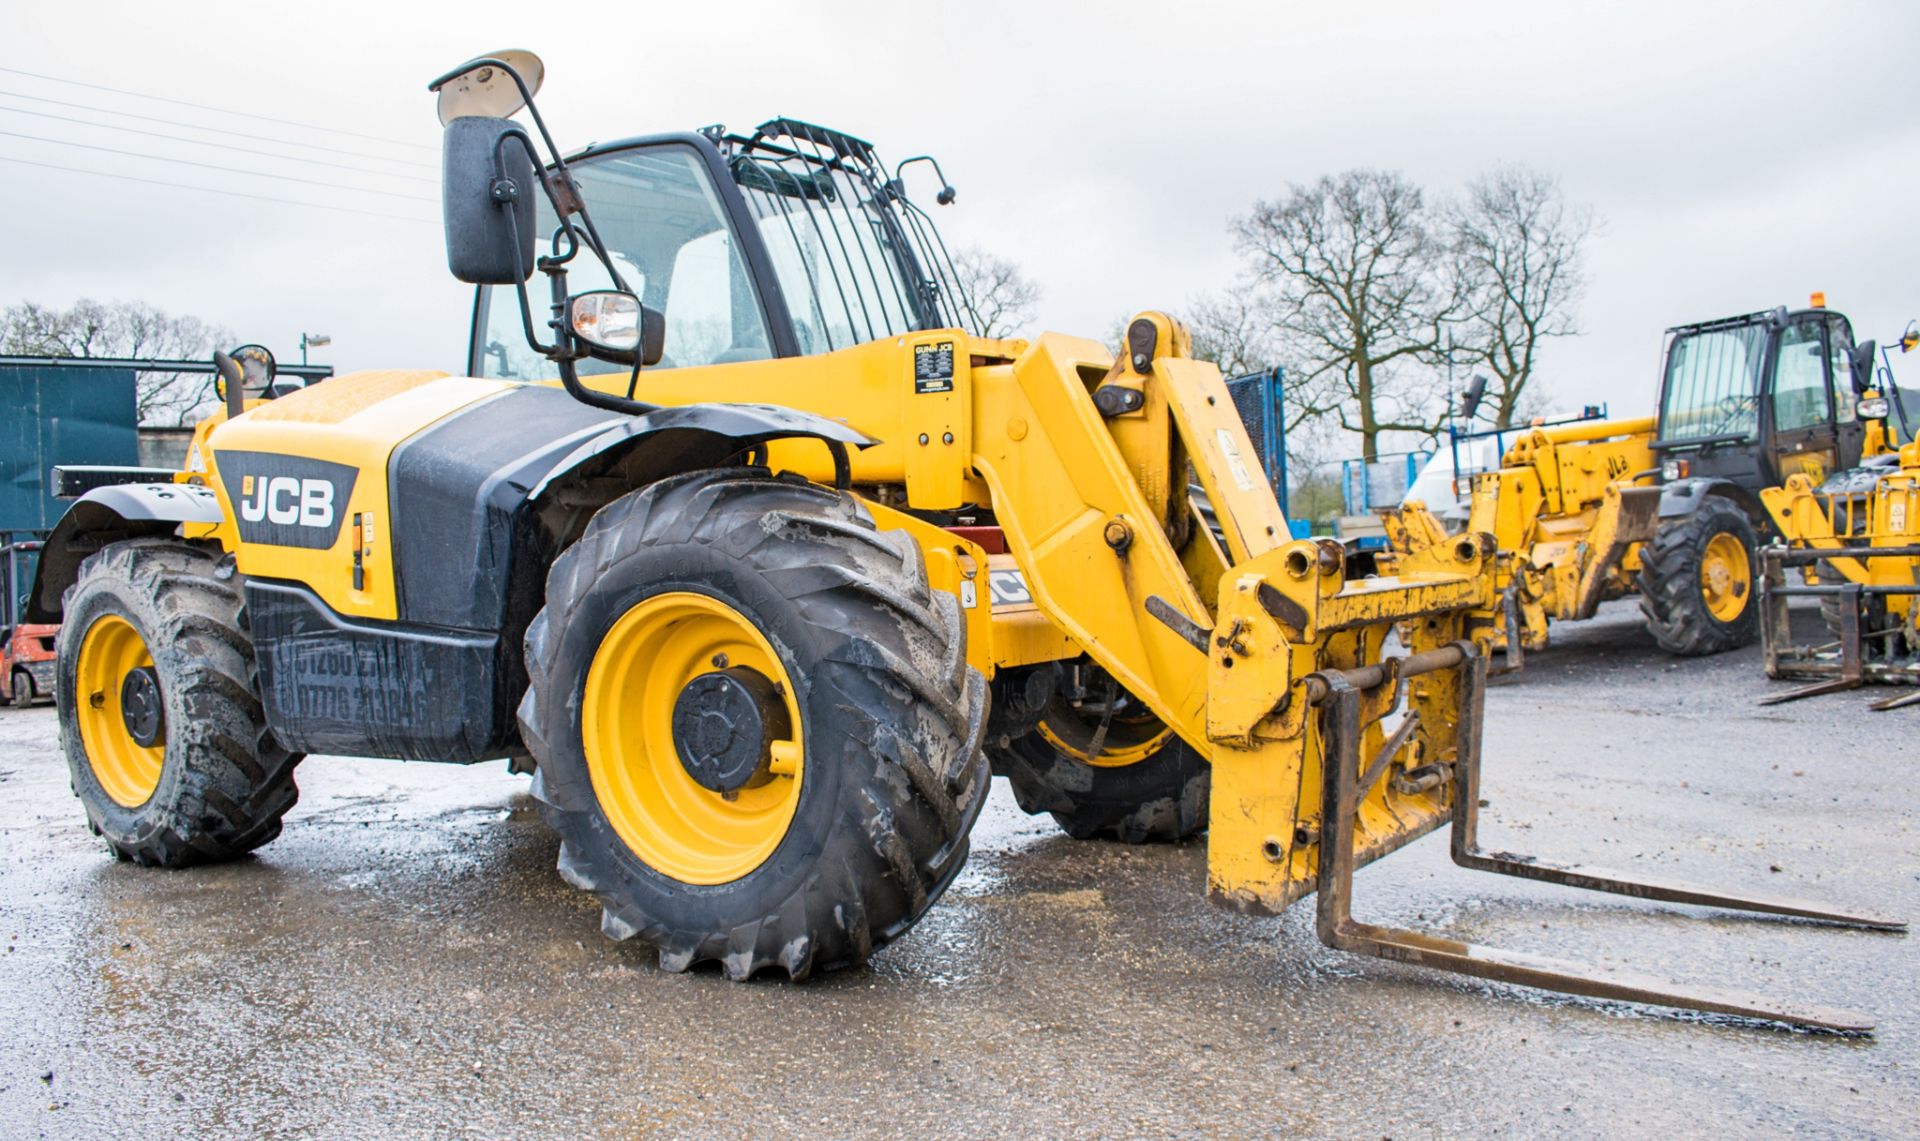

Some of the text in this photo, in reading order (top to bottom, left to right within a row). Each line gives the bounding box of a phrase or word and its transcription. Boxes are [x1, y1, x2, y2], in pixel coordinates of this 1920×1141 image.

[915, 344, 953, 354] GUNN JCB
[241, 475, 335, 529] JCB
